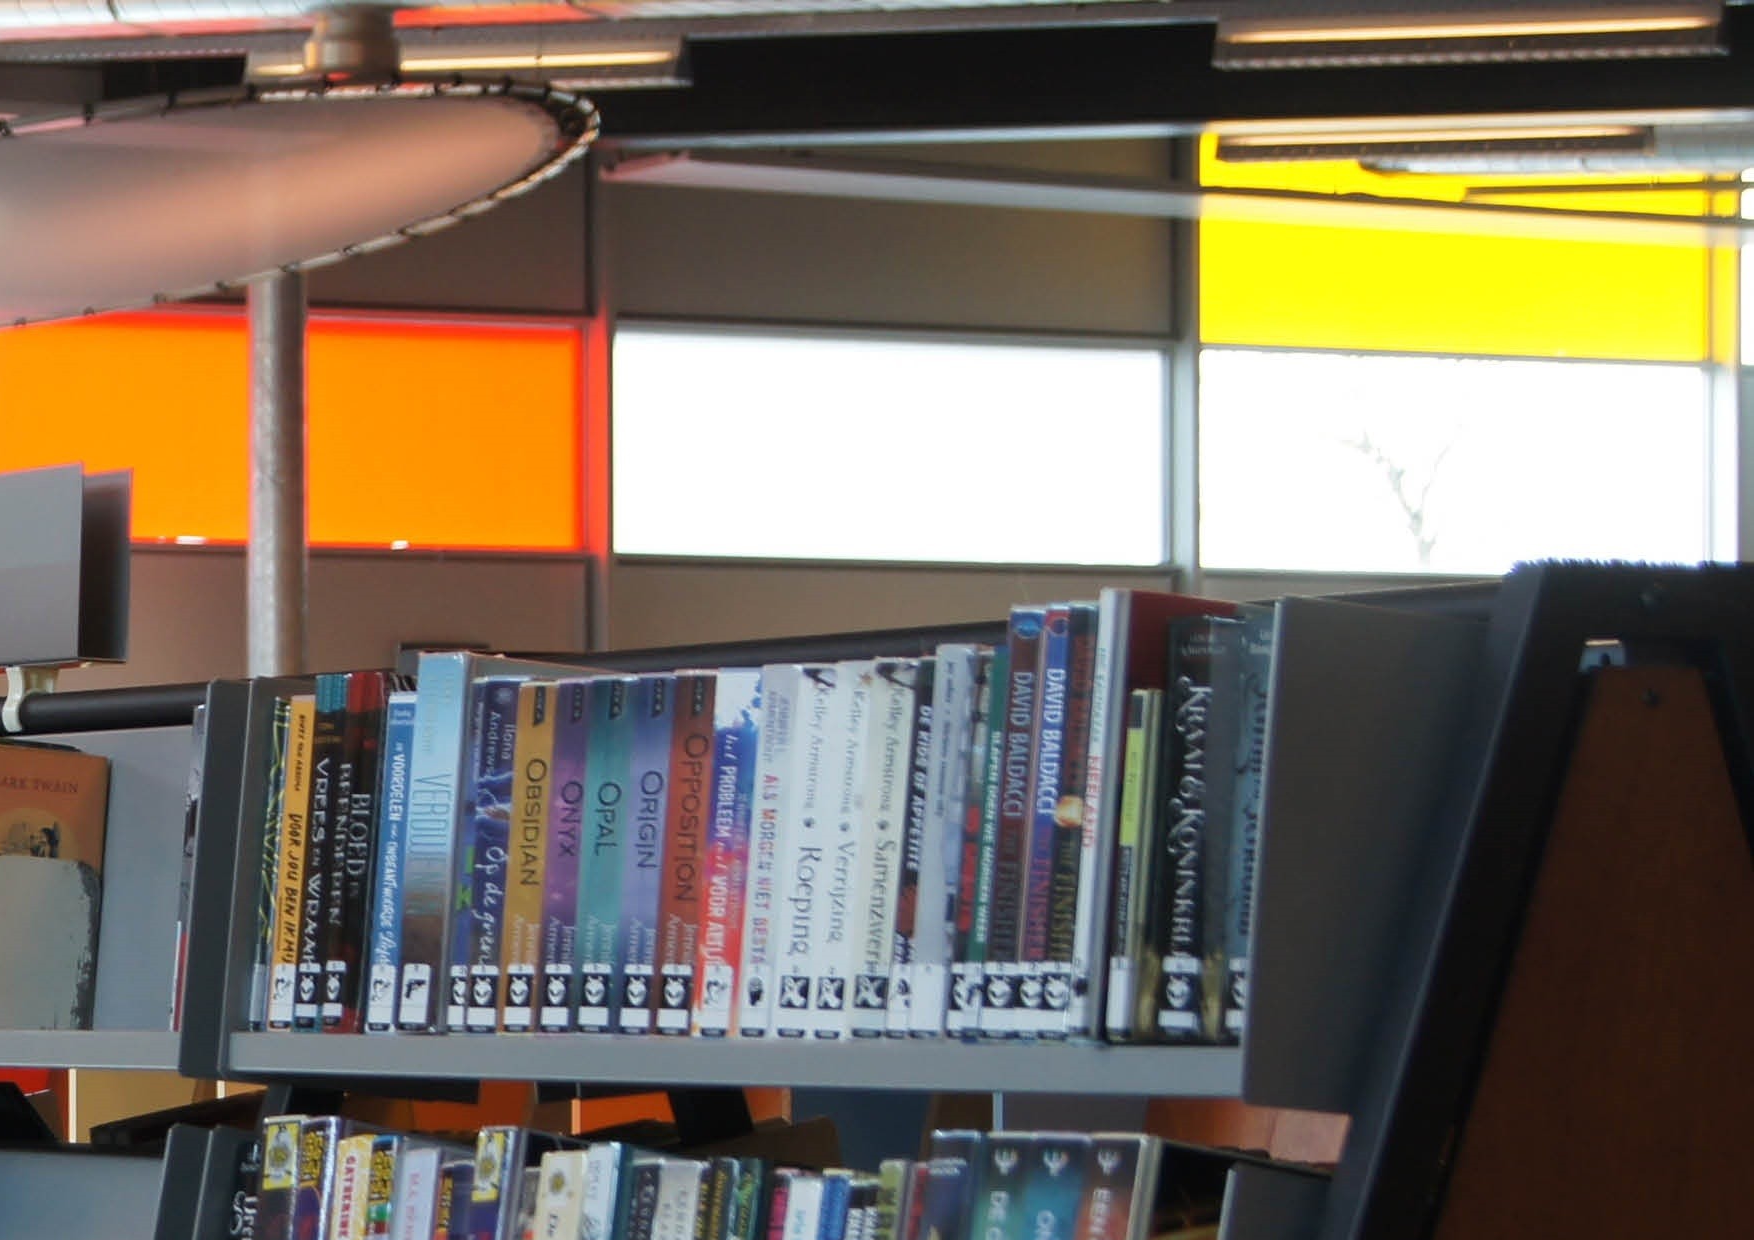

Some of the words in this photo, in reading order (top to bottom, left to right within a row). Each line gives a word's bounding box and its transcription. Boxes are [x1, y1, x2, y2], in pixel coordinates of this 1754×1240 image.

[919, 704, 931, 724] DE
[1010, 670, 1032, 725] DAVID
[1042, 668, 1064, 723] DAVID
[1175, 676, 1211, 770] KRAAI
[915, 730, 929, 765] KIDS
[1004, 731, 1027, 817] BALDACCI
[1037, 729, 1060, 815] BALDACCI
[31, 778, 79, 793] TWAIN
[311, 757, 329, 842] VREES
[388, 753, 406, 821] VOORDELEN
[714, 765, 736, 838] PROBLEEM
[763, 773, 777, 800] ALS
[287, 813, 302, 846] DOOR
[346, 792, 369, 876] BLOED
[516, 757, 548, 886] OBSIDIAN
[555, 779, 582, 858] ONYX
[590, 780, 623, 858] OPAL
[631, 769, 666, 869] ORIGIN
[672, 733, 708, 903] OPPOSITION
[756, 808, 775, 870] MORGEN
[905, 796, 924, 870] APPETITE
[285, 852, 300, 882] JOU
[477, 844, 504, 876] Op
[283, 887, 297, 917] BEN
[485, 882, 503, 906] de
[708, 874, 728, 917] VOOR
[753, 876, 770, 909] NIET
[783, 845, 820, 958] Roeping
[282, 921, 295, 937] IK
[336, 1154, 358, 1239] CATHERINE
[986, 1188, 1007, 1221] DE
[1086, 1186, 1108, 1233] EEN
